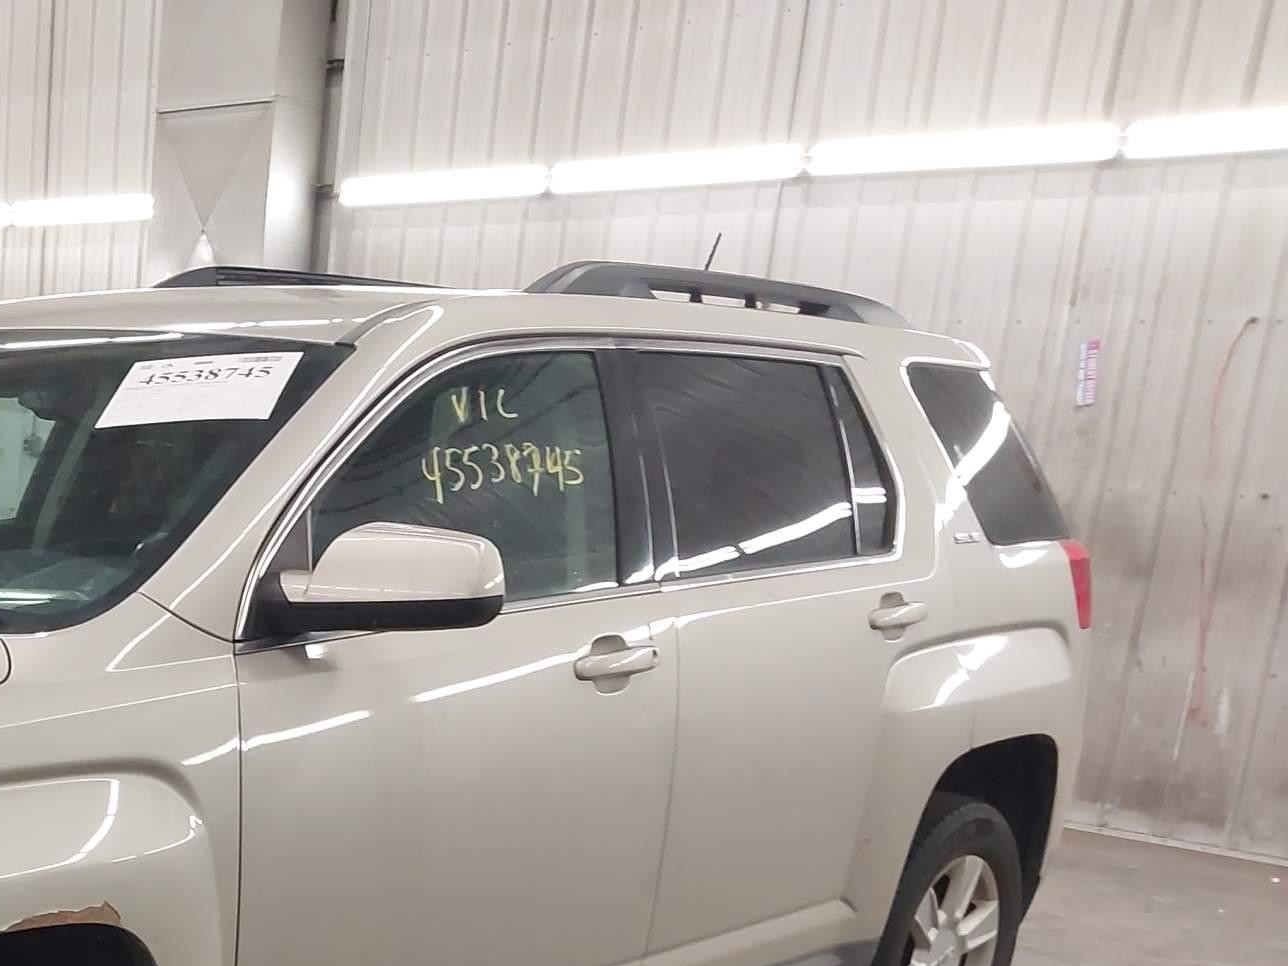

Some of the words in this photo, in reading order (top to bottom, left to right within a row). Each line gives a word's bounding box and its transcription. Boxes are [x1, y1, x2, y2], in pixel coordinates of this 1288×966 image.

[139, 366, 273, 385] 45538745
[451, 386, 519, 422] VIC
[421, 442, 584, 504] 45538745
